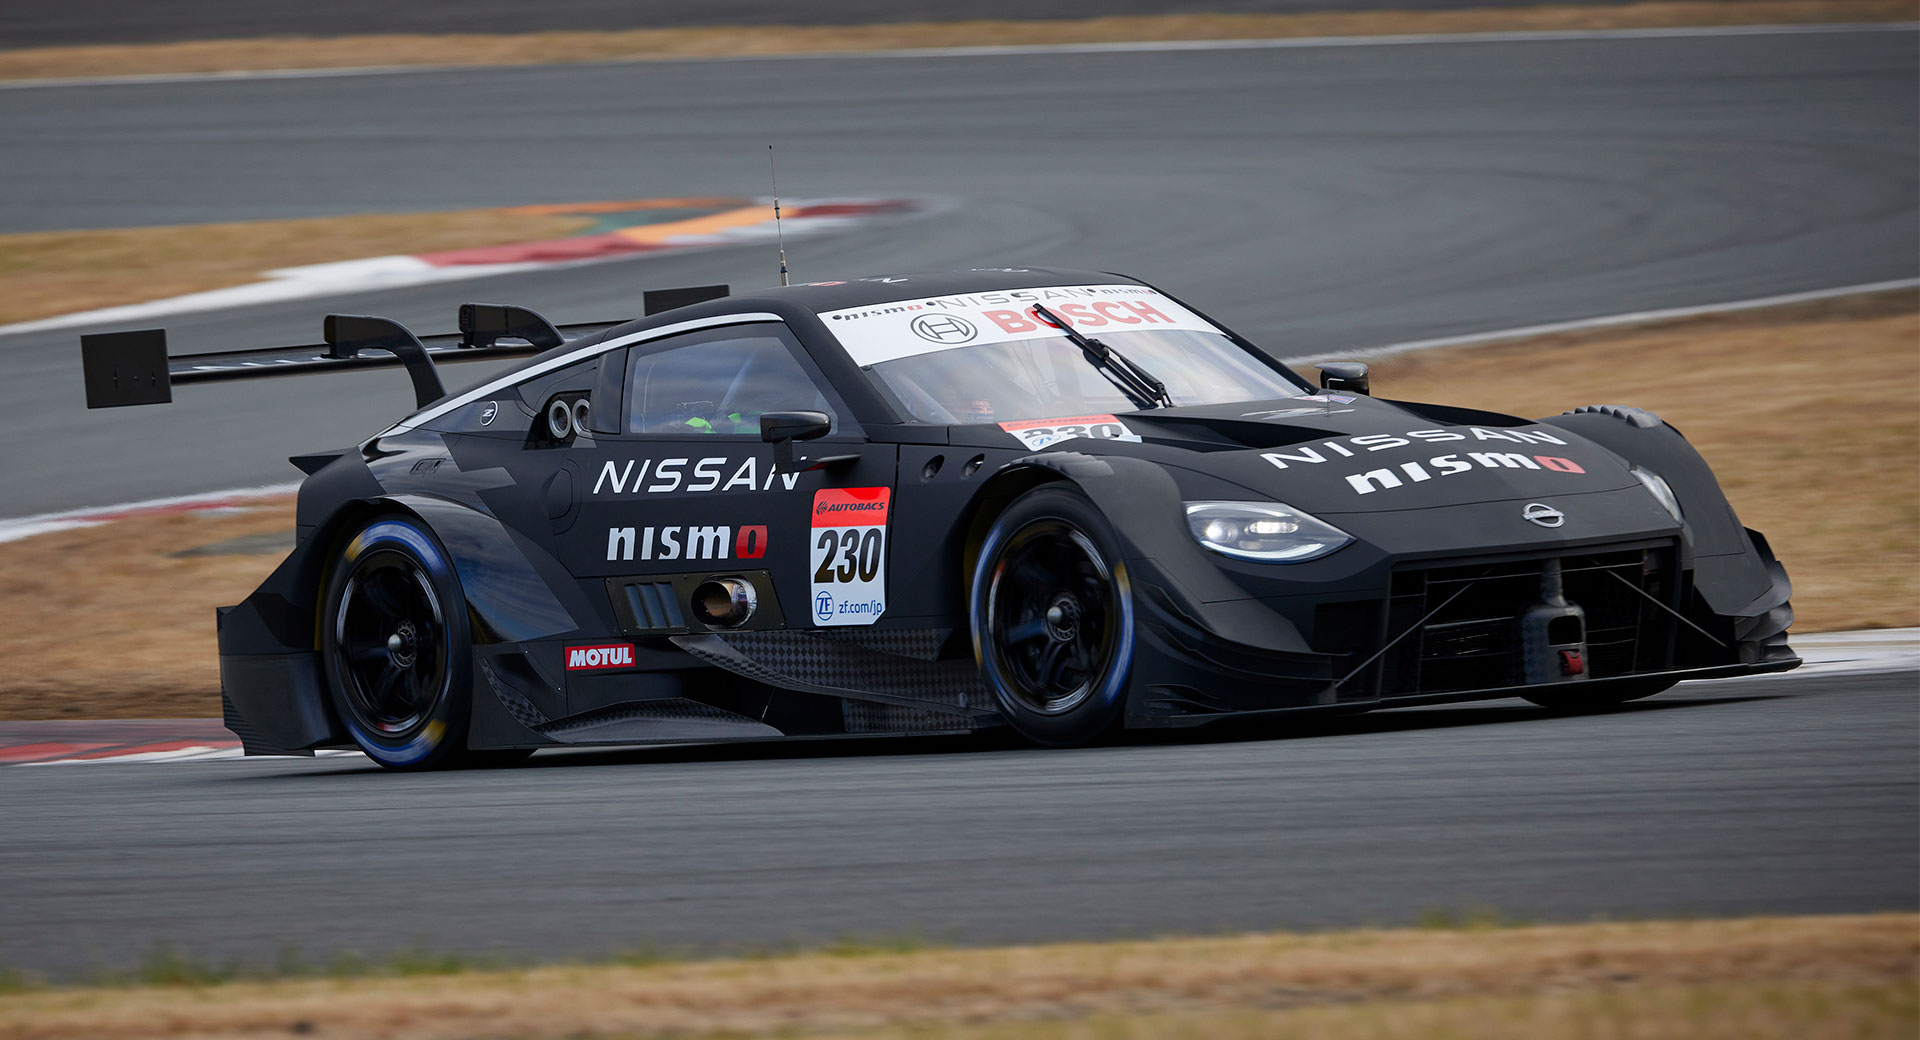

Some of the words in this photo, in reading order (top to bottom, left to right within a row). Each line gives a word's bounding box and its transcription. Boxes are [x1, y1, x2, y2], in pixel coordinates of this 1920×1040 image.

[844, 304, 922, 321] nismo
[935, 288, 1093, 310] NISSAN
[981, 300, 1176, 334] BOSCH
[1259, 427, 1567, 470] NISSAN
[1345, 451, 1586, 495] nismo
[828, 502, 885, 512] AUTOBACS
[607, 525, 767, 561] nismo
[814, 528, 882, 584] 230
[839, 599, 882, 616] zf.com/jp
[569, 647, 633, 667] MOTUL
